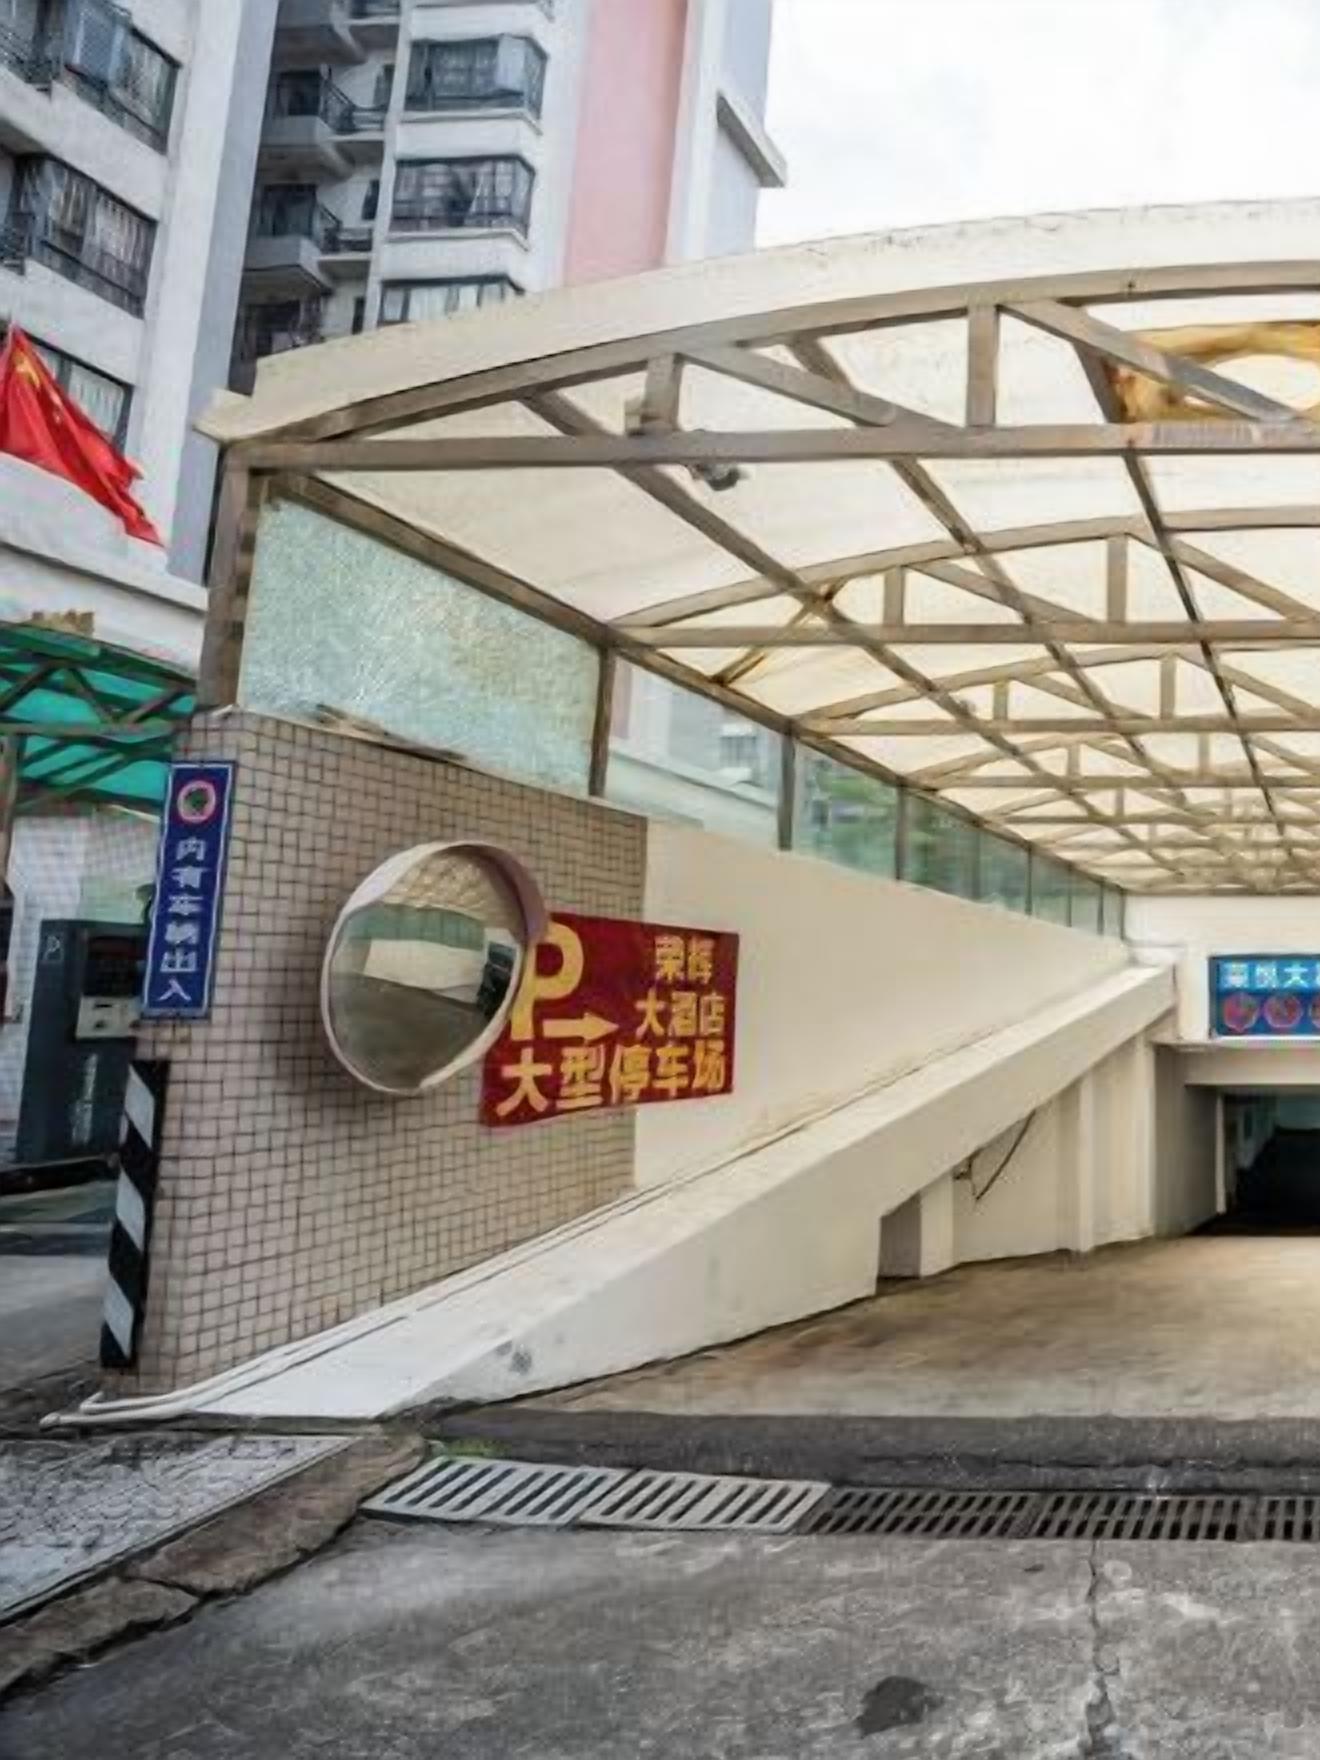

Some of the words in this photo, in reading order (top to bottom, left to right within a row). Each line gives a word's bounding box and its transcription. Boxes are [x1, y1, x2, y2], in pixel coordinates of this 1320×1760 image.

[159, 837, 211, 1001] 内有车辆出入
[510, 920, 584, 1042] P
[635, 986, 726, 1040] 大酒店
[496, 1038, 726, 1117] 大型停车场
